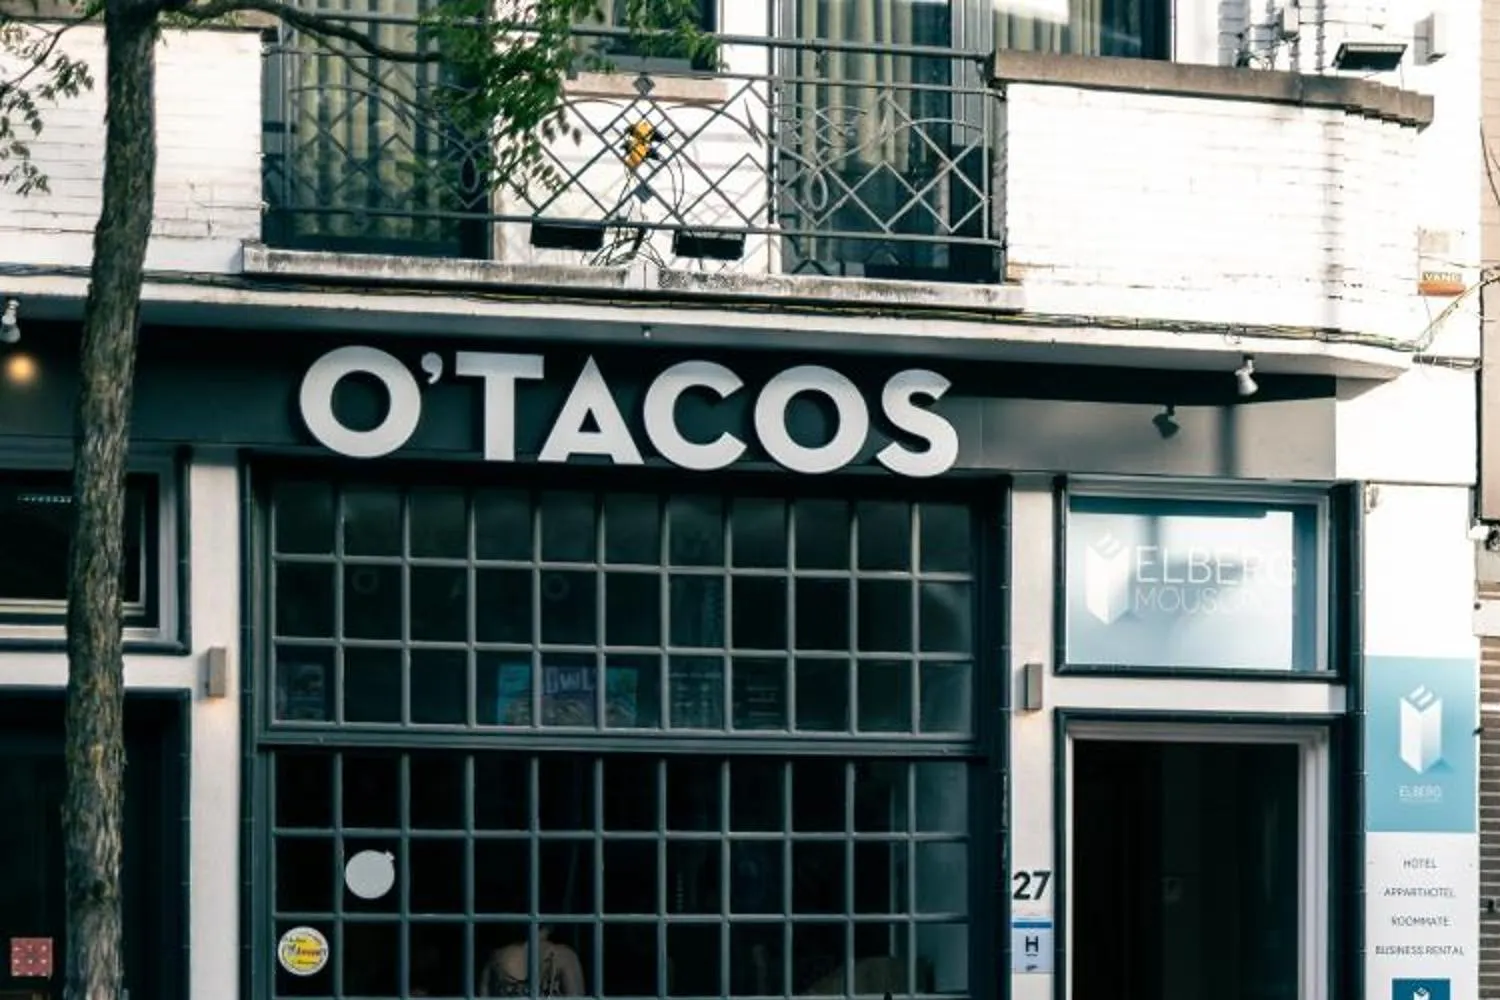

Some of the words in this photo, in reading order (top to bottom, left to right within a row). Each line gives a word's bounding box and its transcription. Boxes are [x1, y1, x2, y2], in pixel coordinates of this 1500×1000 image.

[298, 344, 961, 479] O'TACOS
[1134, 544, 1299, 588] ELBERG
[1403, 857, 1438, 870] HOTEL
[1012, 869, 1053, 901] 27
[1025, 935, 1039, 953] H
[1425, 944, 1464, 957] RENTAL
